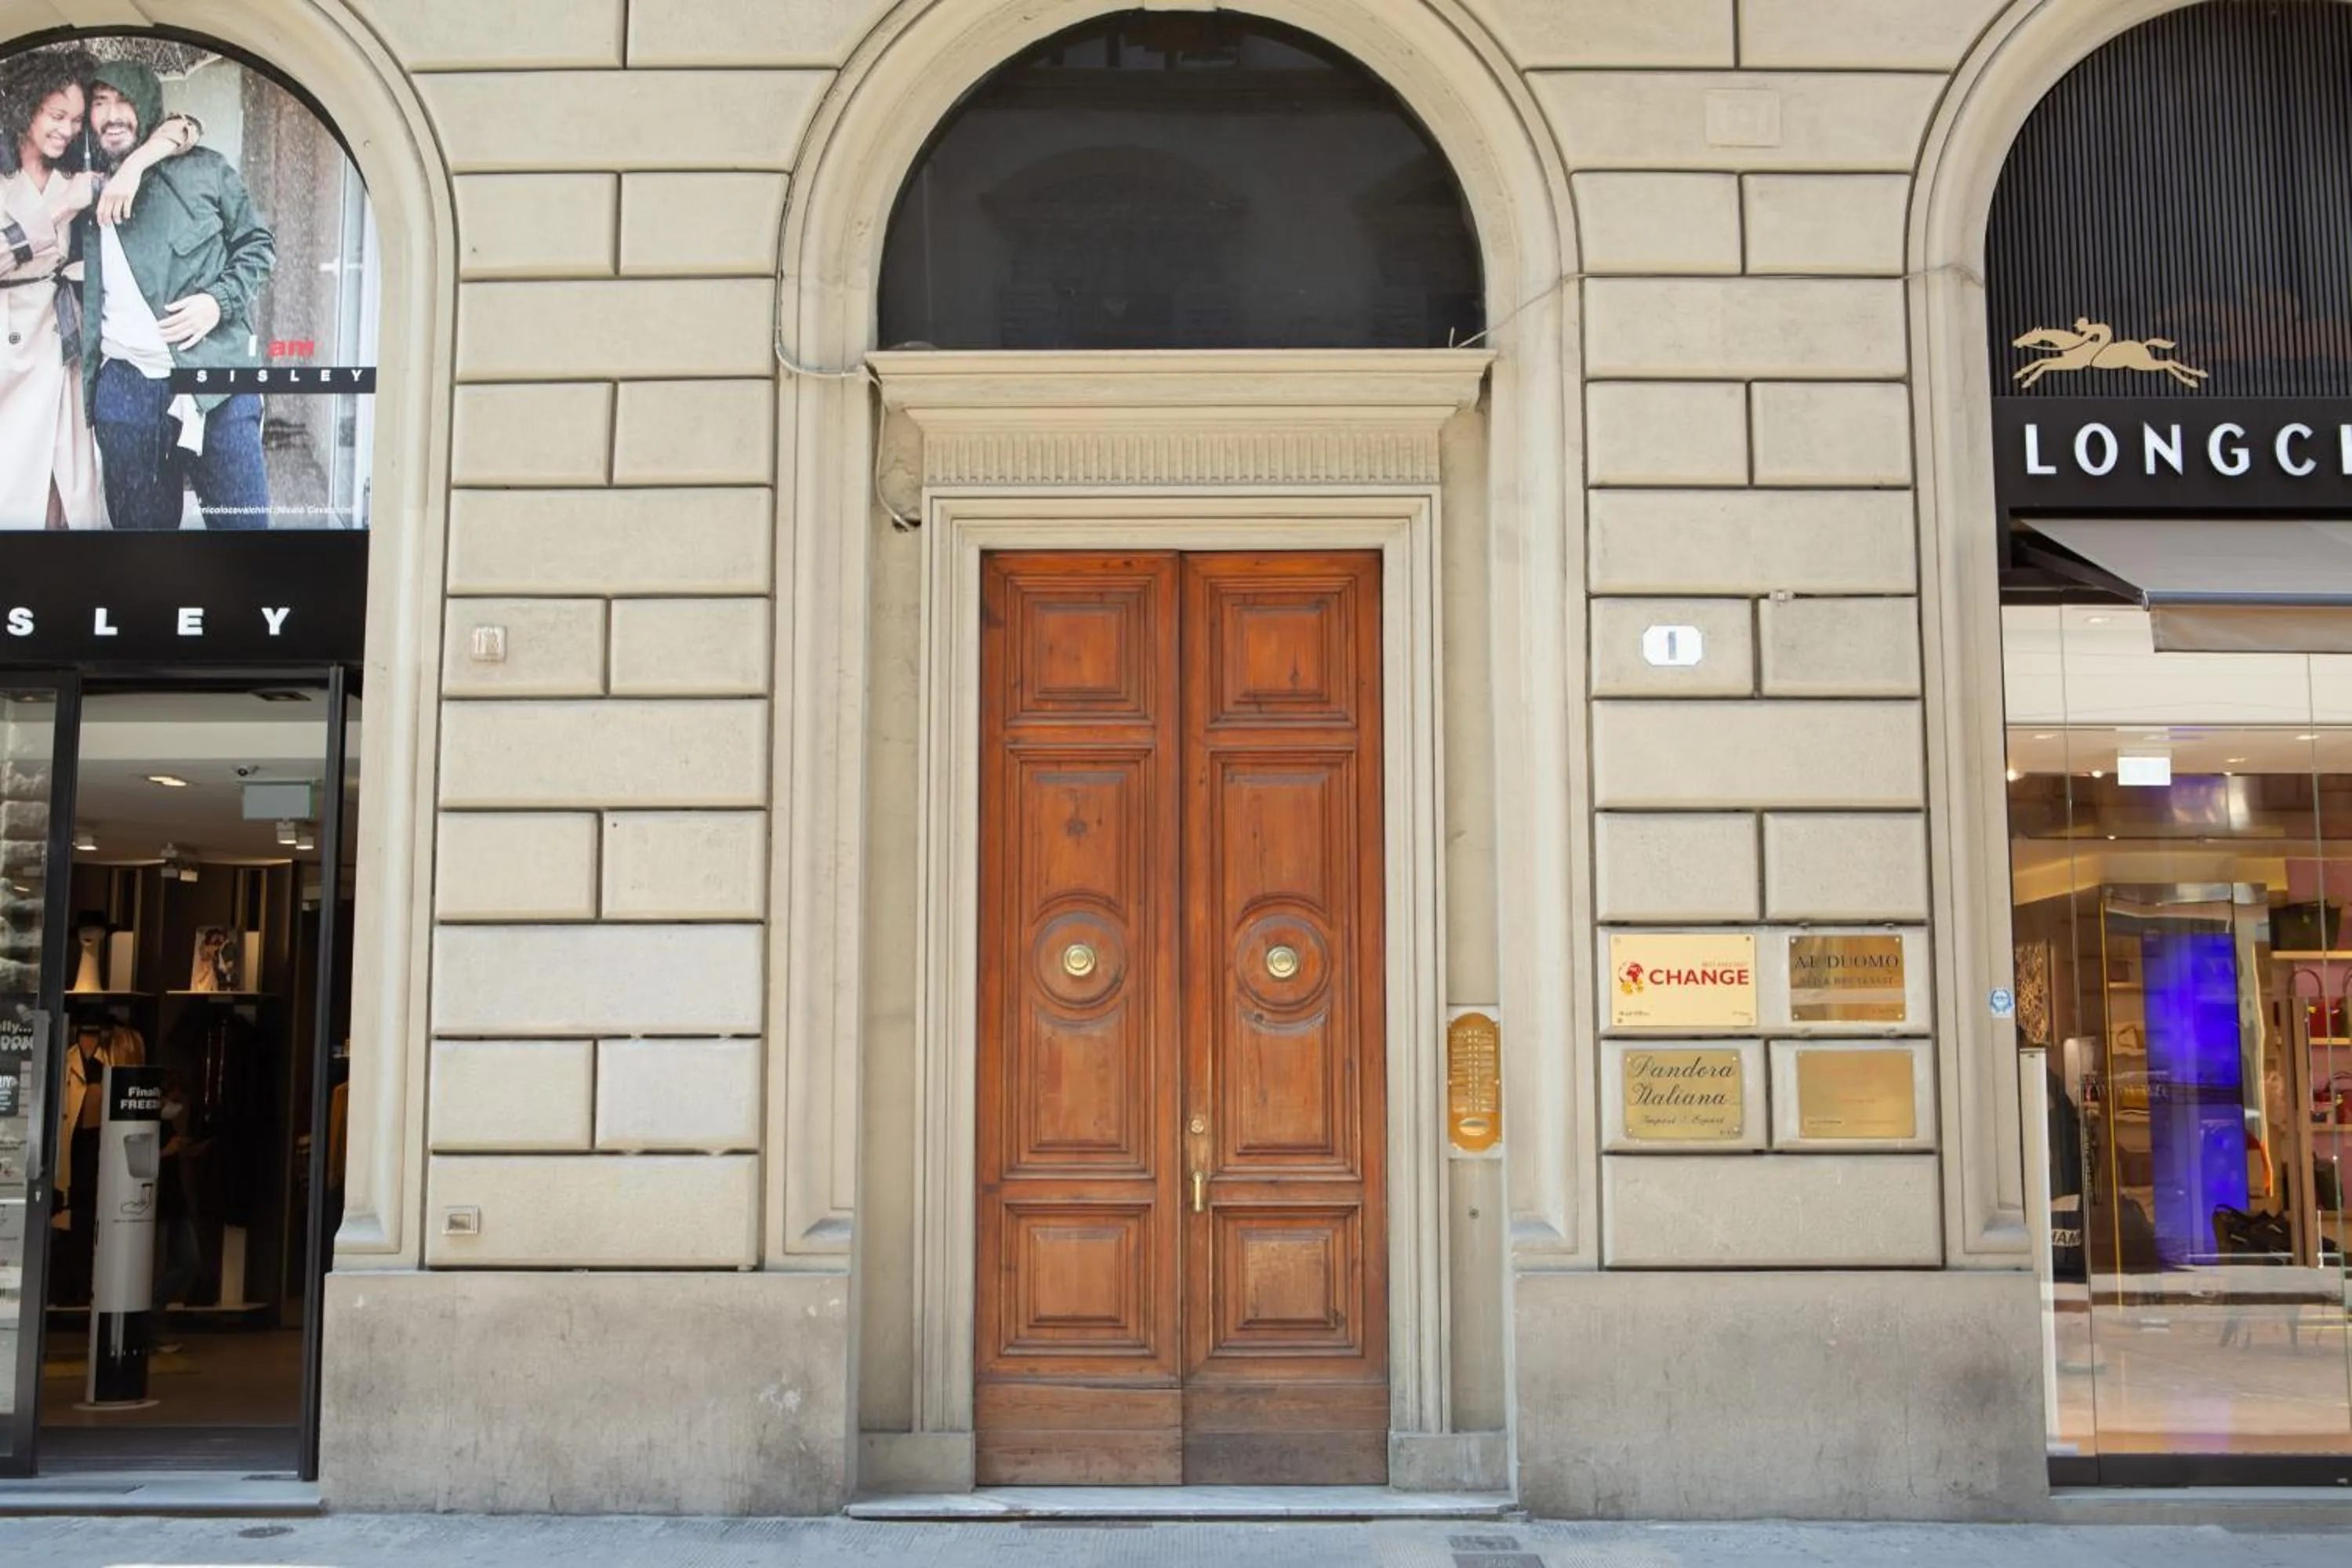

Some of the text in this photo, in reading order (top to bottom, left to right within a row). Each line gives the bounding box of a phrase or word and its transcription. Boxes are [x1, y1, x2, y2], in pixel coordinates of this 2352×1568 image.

[269, 339, 314, 358] am
[197, 369, 363, 383] SISLEY
[2024, 423, 2352, 476] LONGC
[7, 608, 290, 636] SLEY
[1795, 954, 1899, 969] AL DUOMO
[1649, 969, 1749, 985] CHANGE
[1631, 1054, 1733, 1078] Pandora
[1631, 1082, 1727, 1105] Italiana
